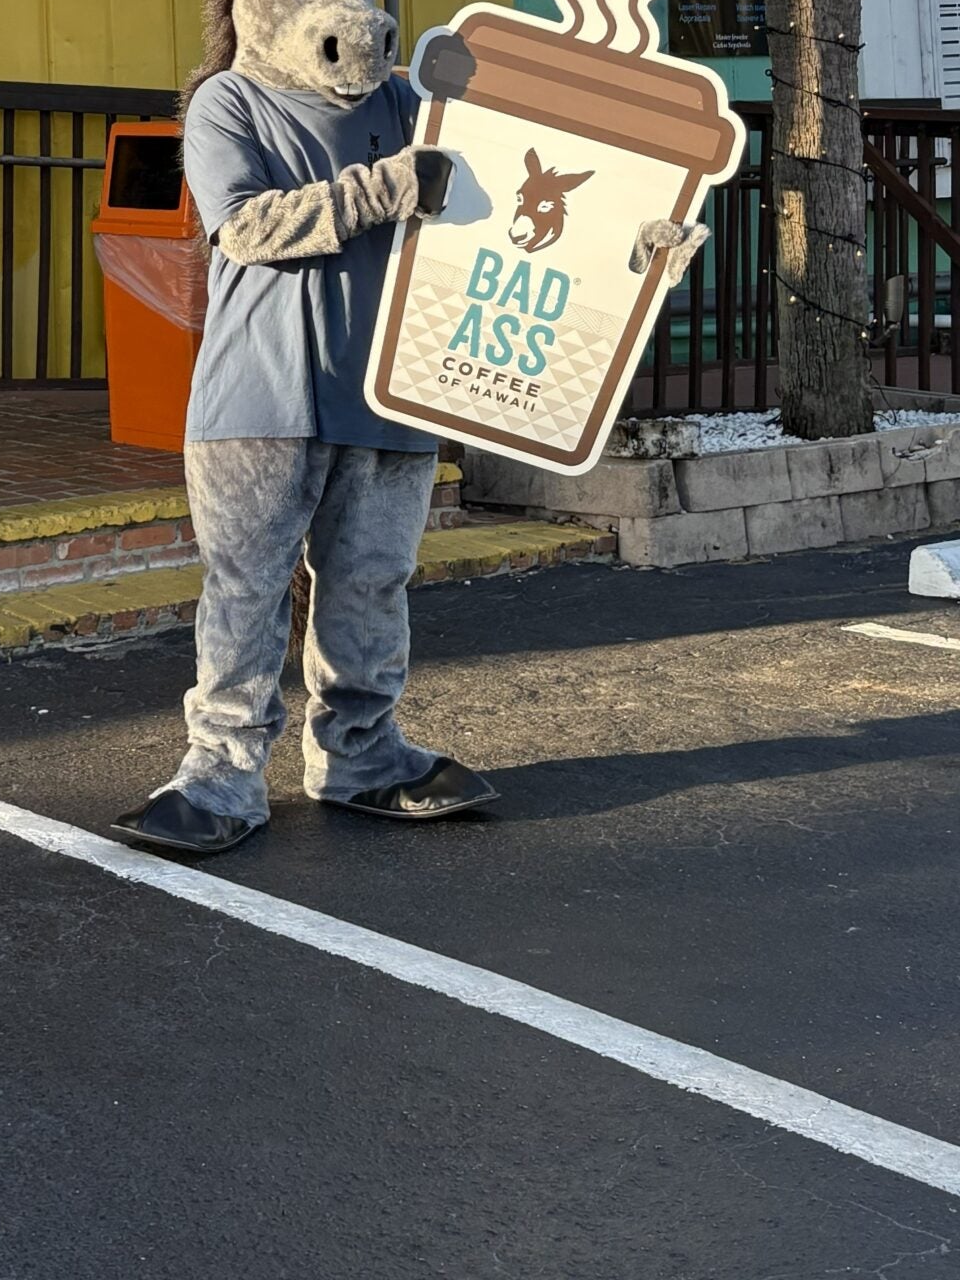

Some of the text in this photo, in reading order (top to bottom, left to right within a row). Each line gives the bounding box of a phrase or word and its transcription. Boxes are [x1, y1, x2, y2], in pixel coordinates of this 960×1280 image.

[466, 247, 571, 322] BAD
[447, 303, 556, 376] ASS
[438, 374, 536, 412] OF HAWAII
[442, 356, 541, 398] COFFEE
